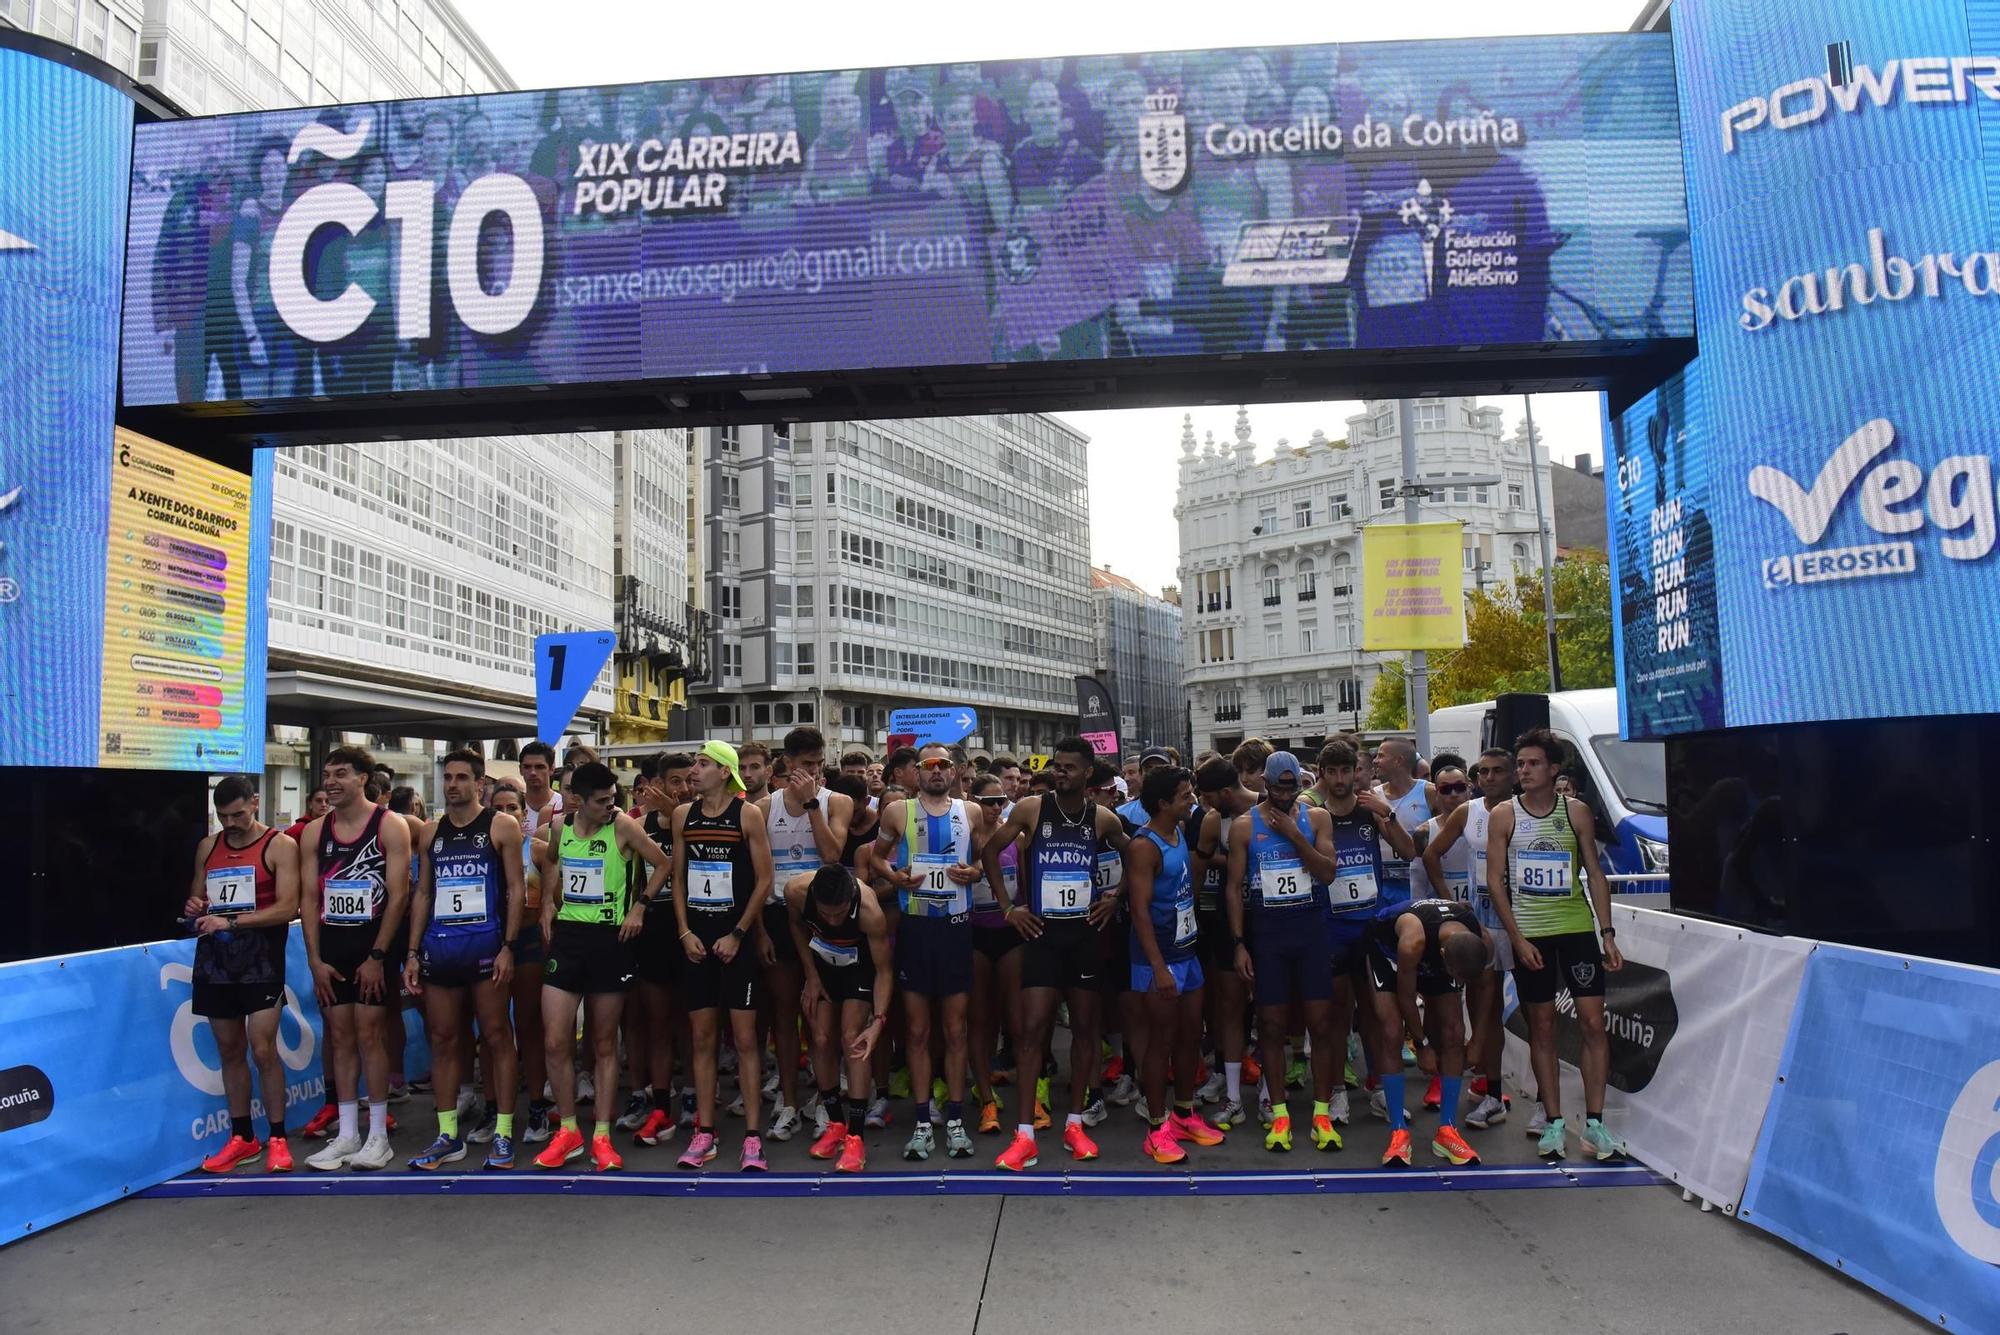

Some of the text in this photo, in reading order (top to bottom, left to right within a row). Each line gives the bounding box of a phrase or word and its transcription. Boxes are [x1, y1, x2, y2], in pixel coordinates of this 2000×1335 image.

[1205, 111, 1519, 156] Concello da Coruña
[574, 131, 801, 179] XIX CARREIRA
[573, 173, 727, 216] POPULAR
[1749, 418, 2000, 561] Veg
[138, 489, 173, 511] XENTE
[174, 500, 195, 518] DOS
[195, 509, 238, 531] BARRIOS
[1651, 495, 1682, 537] RUN
[147, 508, 220, 538] CORRE NA CORUÑA
[1653, 526, 1684, 566] RUN
[1802, 549, 1907, 577] EROSKI
[1654, 557, 1687, 596] RUN
[1655, 587, 1689, 625] RUN
[1657, 618, 1691, 654] RUN
[548, 645, 567, 691] 1
[1032, 758, 1040, 770] 3
[450, 853, 481, 861] ATLETISMO
[1039, 850, 1092, 867] NARÓN
[1335, 852, 1374, 867] ARÓN
[434, 860, 489, 878] NARÓN
[1523, 867, 1564, 887] 8511
[570, 874, 587, 894] 27
[703, 879, 712, 897] 4
[928, 870, 945, 889] 10
[1277, 876, 1297, 895] 25
[219, 883, 238, 903] 47
[1058, 888, 1077, 907] 19
[1348, 882, 1359, 899] 6
[1453, 885, 1469, 901] 14
[329, 895, 365, 915] 3084
[453, 894, 463, 913] 5
[0, 1088, 41, 1110] oruña
